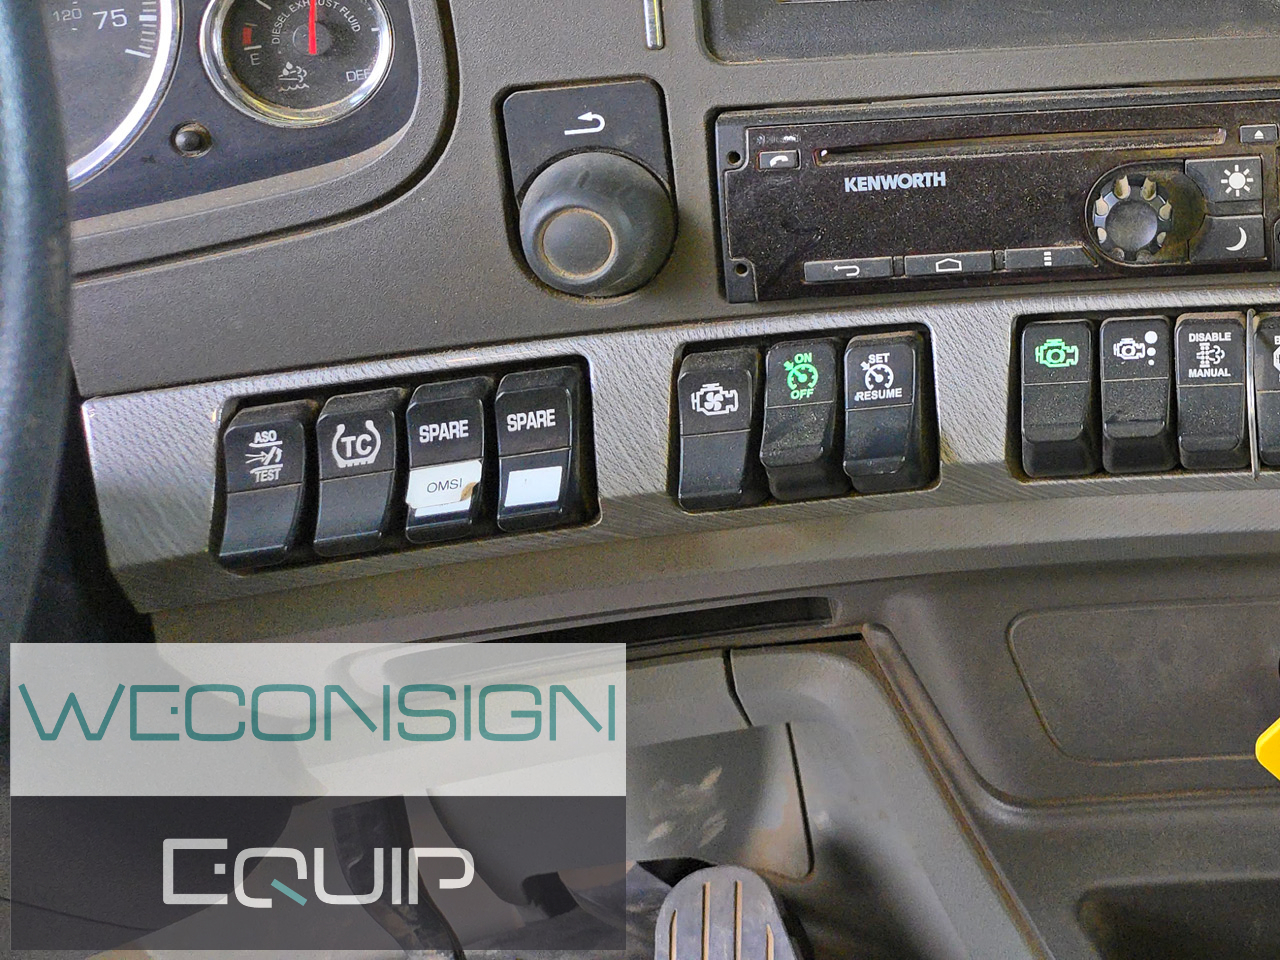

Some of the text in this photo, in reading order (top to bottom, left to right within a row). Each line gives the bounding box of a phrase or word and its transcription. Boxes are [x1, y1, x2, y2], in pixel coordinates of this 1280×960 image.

[53, 8, 82, 22] 120
[92, 8, 128, 30] 75
[271, 12, 291, 45] DIESEL
[339, 6, 361, 33] FLUID
[250, 53, 261, 66] E
[844, 171, 946, 193] KENWORTH
[1188, 332, 1232, 343] DISABLE
[794, 352, 813, 364] ON
[868, 352, 891, 364] SET
[1188, 368, 1231, 378] MANUAL
[790, 388, 814, 400] OFF
[855, 388, 902, 401] RESUME
[506, 408, 556, 432] SPARE
[419, 419, 469, 444] SPARE
[340, 433, 372, 458] TC
[254, 468, 281, 483] TEST
[427, 478, 462, 494] OMSI
